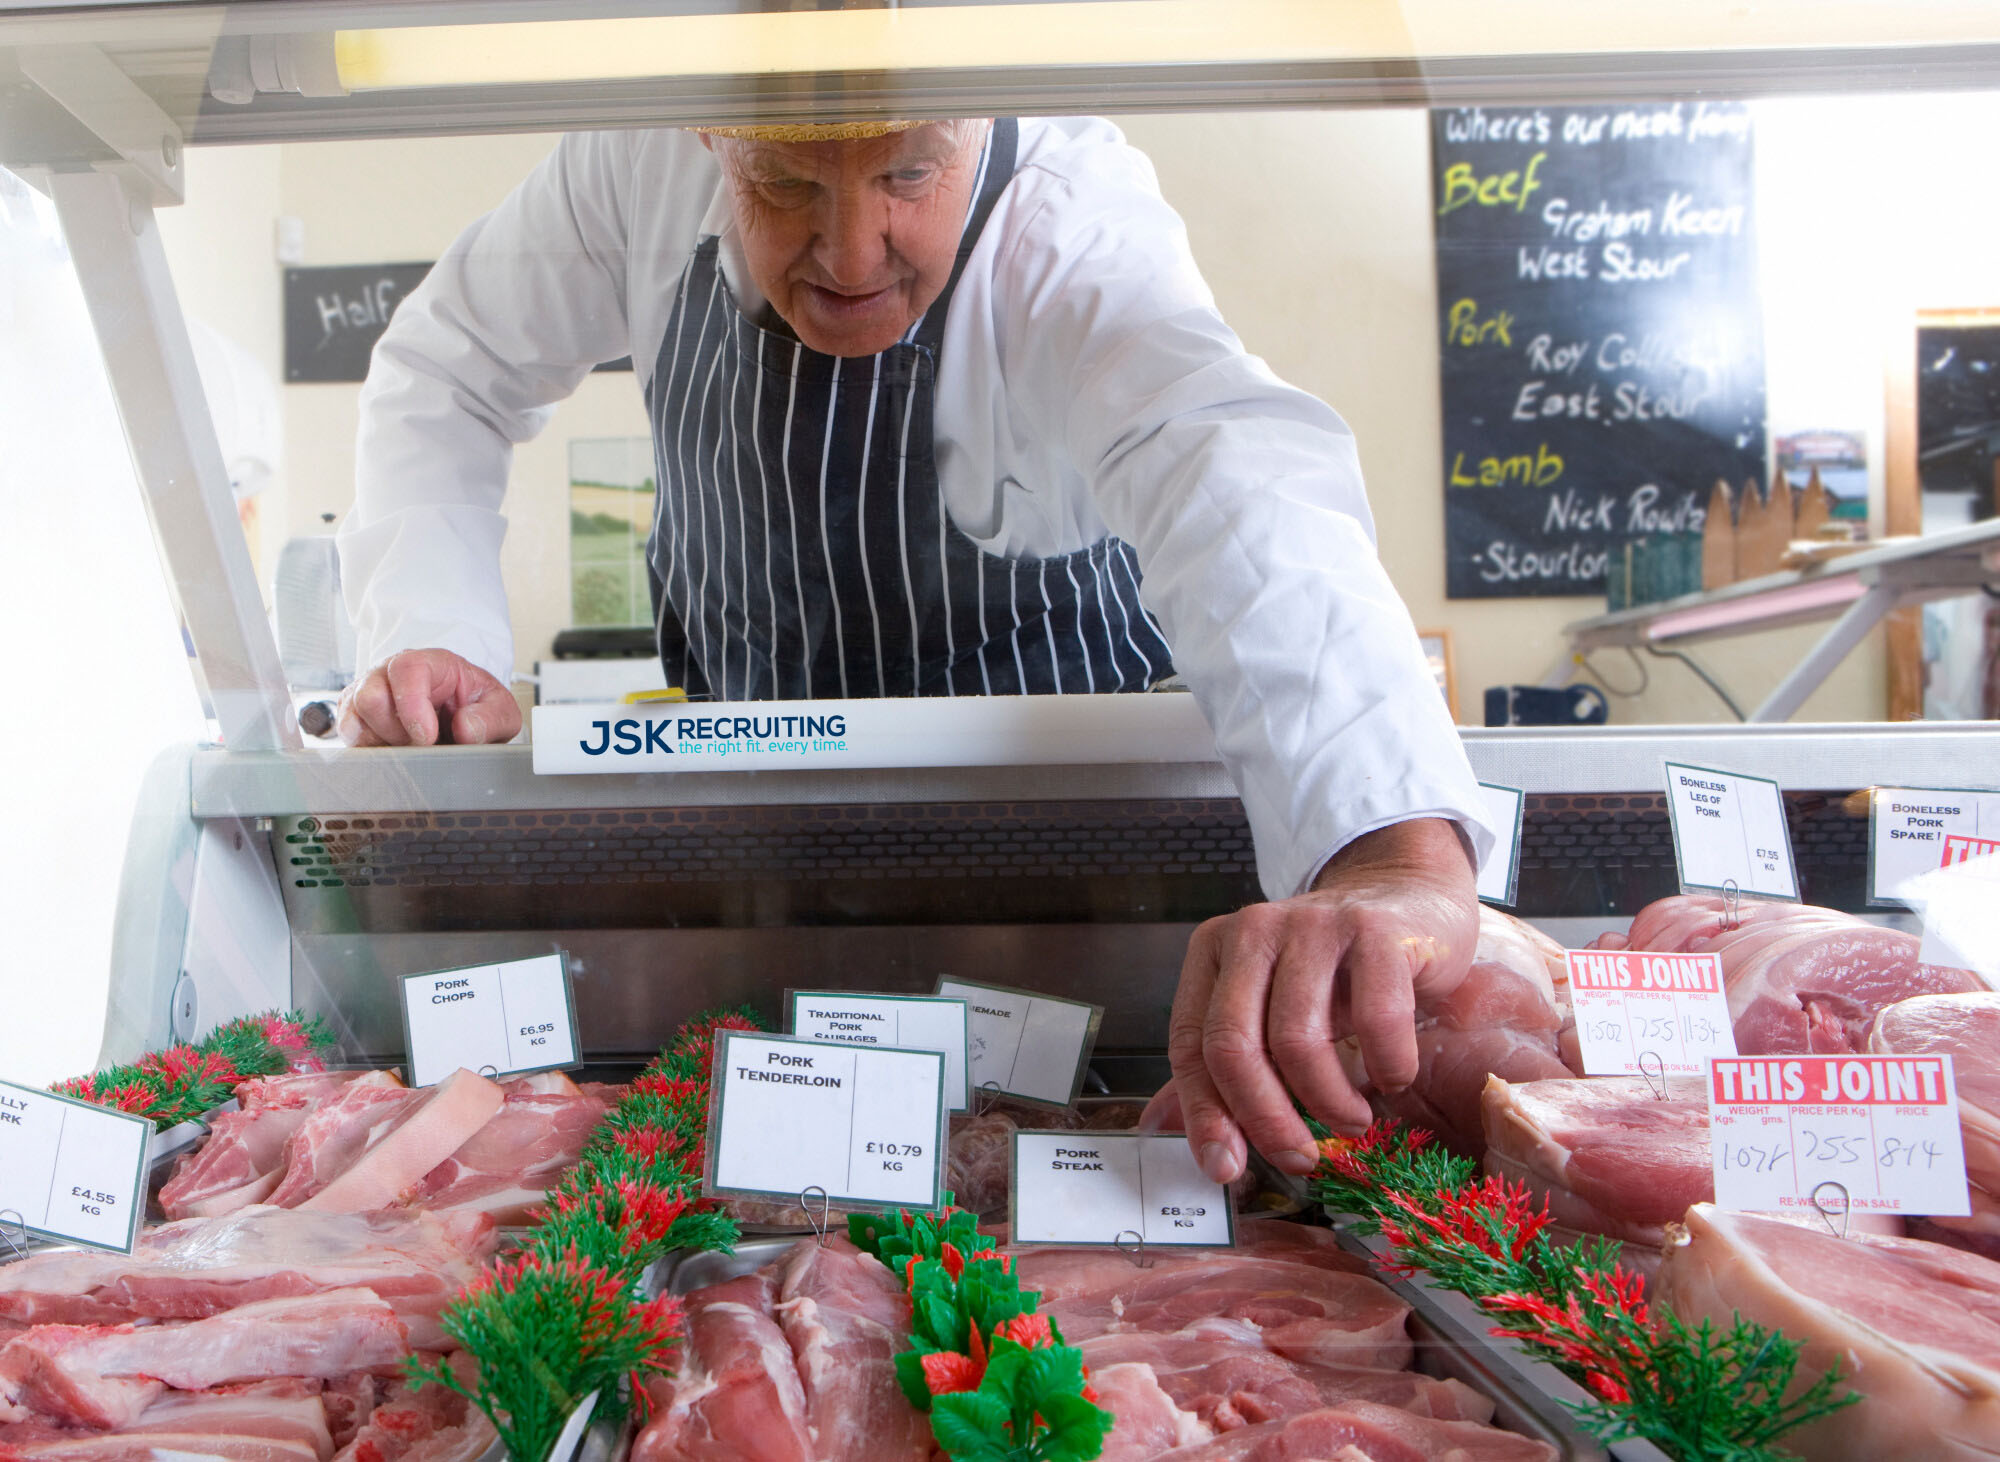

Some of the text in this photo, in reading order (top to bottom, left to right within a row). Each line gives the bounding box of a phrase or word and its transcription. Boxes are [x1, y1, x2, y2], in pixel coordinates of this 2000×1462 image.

[1564, 113, 1608, 144] our
[1438, 152, 1546, 213] Beef
[1543, 198, 1652, 241] Graham
[1518, 242, 1691, 281] West Stour
[316, 279, 395, 336] Half
[1448, 298, 1514, 346] Pork
[1527, 334, 1589, 375] Roy
[1512, 381, 1600, 420] East
[1450, 443, 1564, 486] Lamb
[1543, 489, 1616, 533] Nick
[579, 715, 846, 755] JSK RECRUITING
[678, 738, 849, 757] the right fit. every time.
[1680, 775, 1727, 793] BONELESS
[1690, 791, 1721, 805] LEG OF
[1695, 805, 1721, 818] PORK
[1891, 803, 1961, 815] BONELESS
[1907, 817, 1944, 828] PORK
[1890, 829, 1934, 841] SPARE
[1756, 848, 1779, 861] £7.55
[1764, 863, 1775, 872] KG
[1572, 954, 1713, 990] THIS JOINT
[434, 978, 470, 991] PORK
[431, 990, 475, 1005] CHOPS
[1584, 991, 1612, 999] WEIGHT
[1624, 992, 1645, 1000] PRICE
[807, 1009, 886, 1022] TRADITIONAL
[519, 1023, 555, 1036] £6.95
[829, 1021, 863, 1032] PORK
[530, 1037, 546, 1046] KG
[814, 1032, 878, 1044] SAUSAGES
[767, 1052, 814, 1068] PORK
[1682, 1064, 1700, 1072] SALE
[736, 1066, 842, 1088] TENDERLOIN
[1716, 1061, 1941, 1102] THIS JOINT
[0, 1096, 28, 1110] LLY
[1728, 1106, 1770, 1115] WEIGHT
[1791, 1107, 1823, 1115] PRICE
[1826, 1107, 1848, 1115] PER
[1896, 1107, 1929, 1116] PRICE
[0, 1111, 22, 1126] RK
[866, 1142, 922, 1157] £10.79
[1055, 1149, 1099, 1158] PORK
[882, 1161, 903, 1172] KG
[1052, 1161, 1103, 1171] STEAK
[71, 1186, 116, 1205] £4.55
[1779, 1197, 1900, 1208] RE-WEGHED ON SALE
[81, 1203, 101, 1216] KG
[1161, 1206, 1206, 1216] £8.39
[1174, 1219, 1194, 1228] KG
